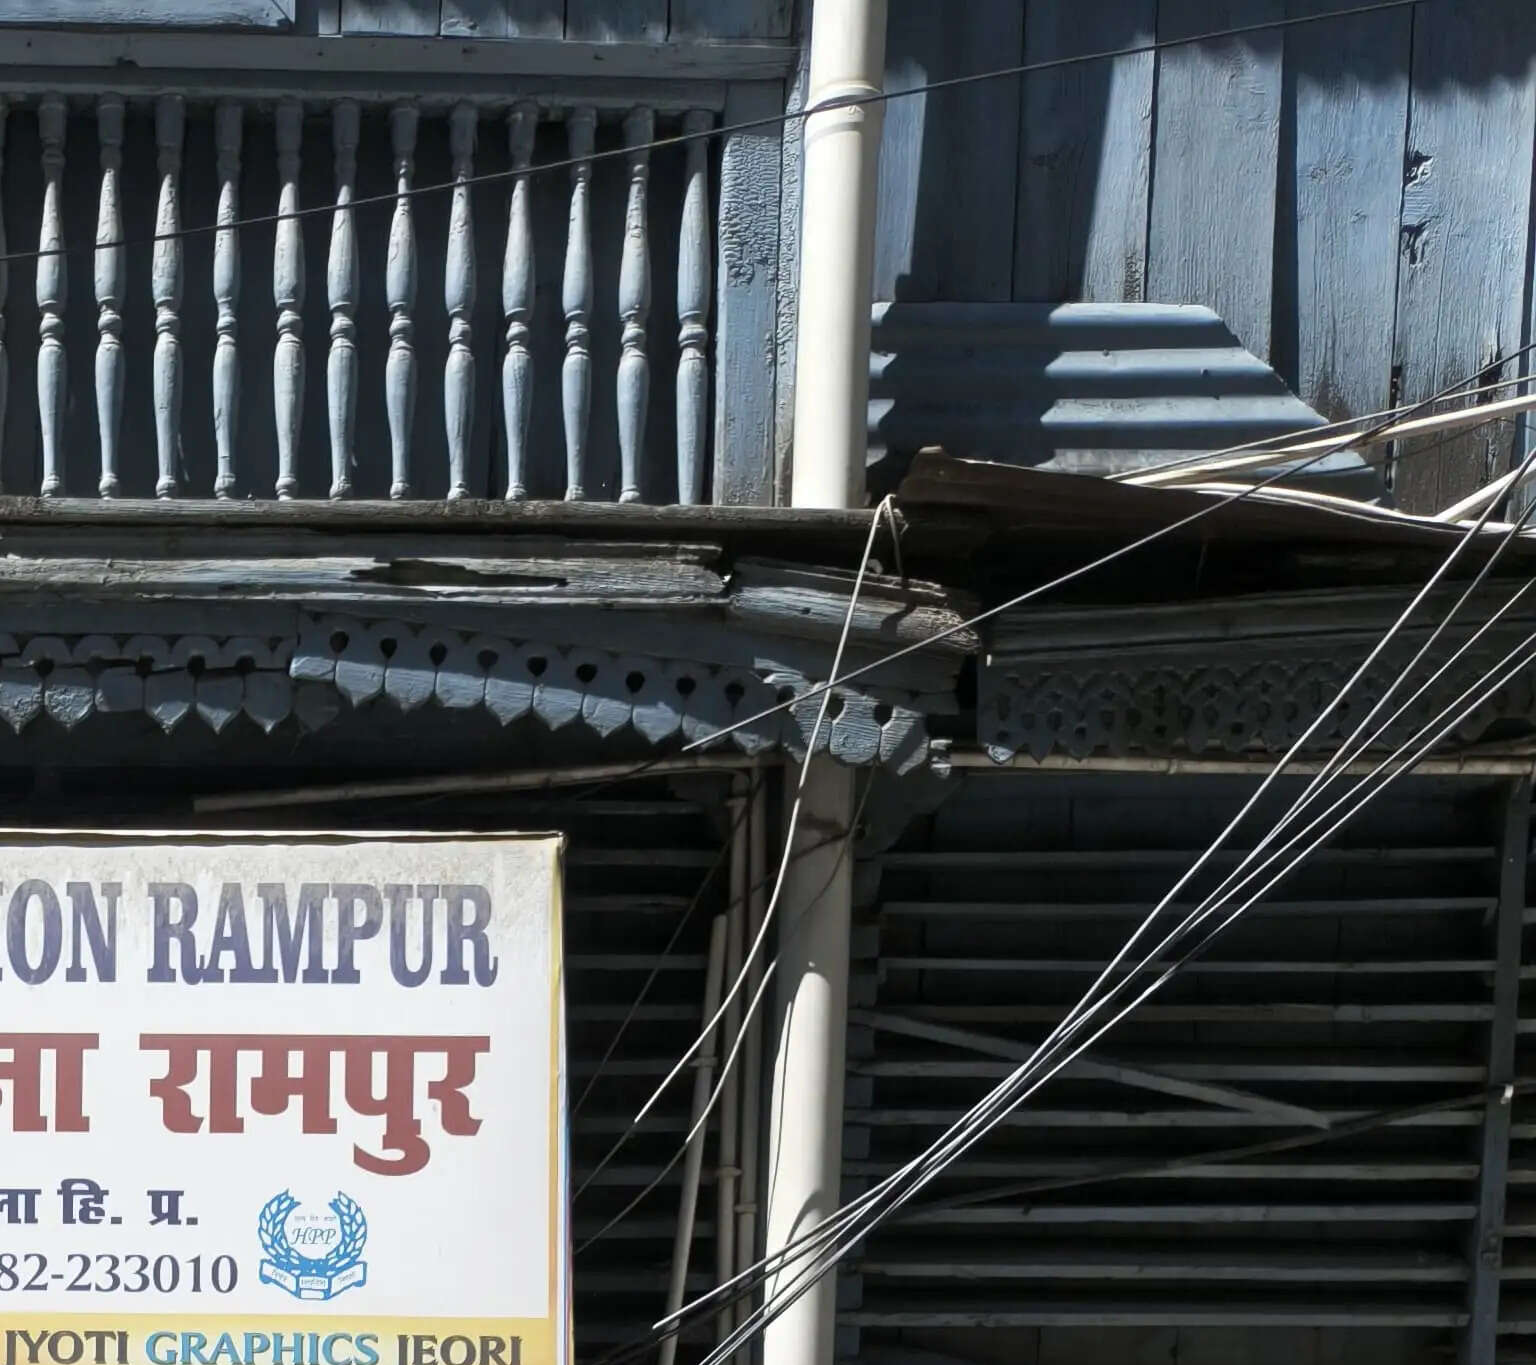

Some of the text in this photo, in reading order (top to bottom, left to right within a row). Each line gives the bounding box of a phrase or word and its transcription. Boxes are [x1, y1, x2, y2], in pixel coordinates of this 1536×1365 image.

[146, 881, 499, 988] RAMPUR
[139, 1032, 490, 1176] रामपुर
[57, 1178, 122, 1225] हि.
[147, 1190, 198, 1225] प्र.
[290, 1227, 337, 1245] HPP
